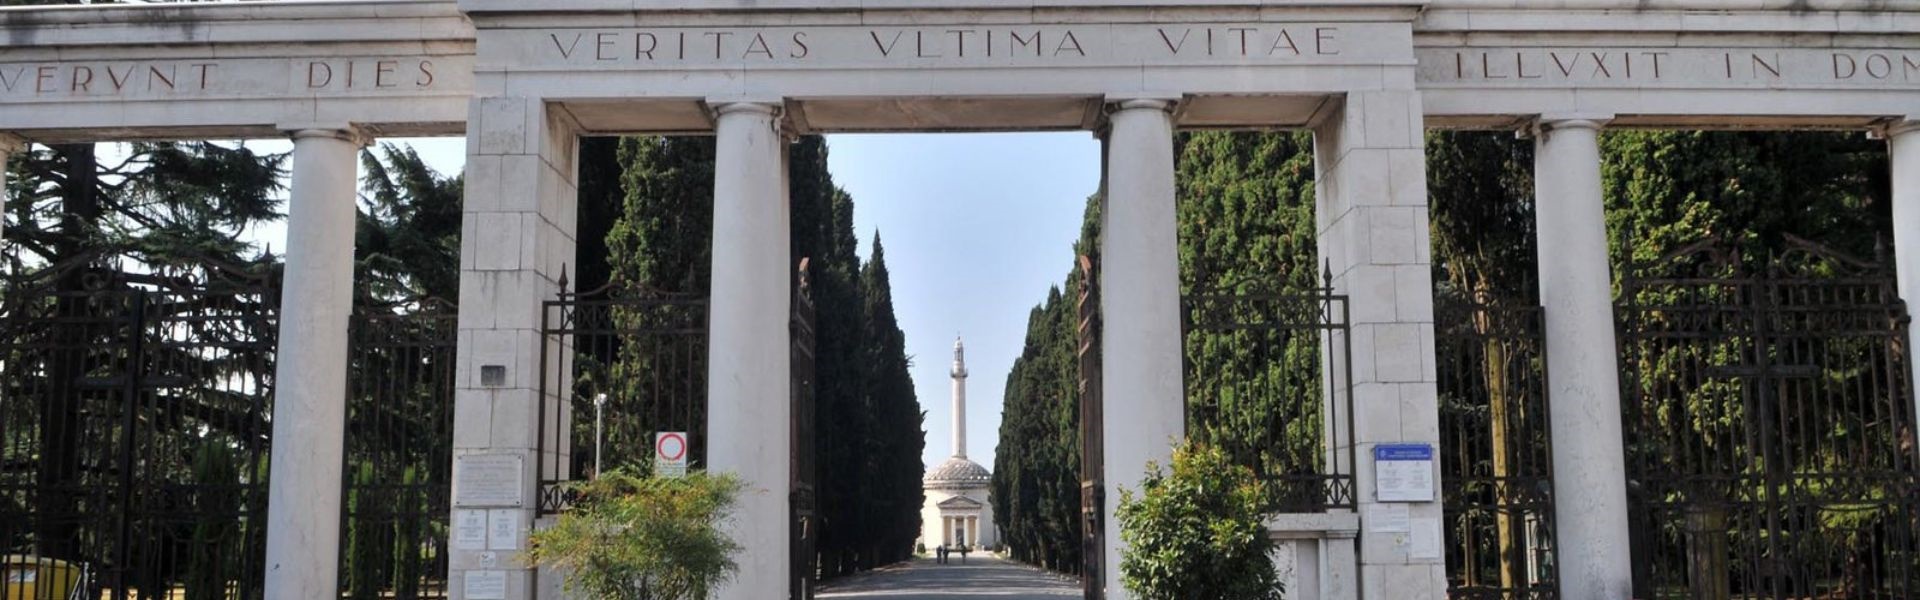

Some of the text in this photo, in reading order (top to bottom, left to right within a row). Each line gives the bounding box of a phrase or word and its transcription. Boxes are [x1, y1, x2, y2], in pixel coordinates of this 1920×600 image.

[551, 27, 1340, 60] VERITAS VLTIMA VITAE
[0, 60, 434, 93] VERVNT DIES
[1455, 51, 1669, 79] ILLVXIT
[1725, 52, 1782, 79] IN
